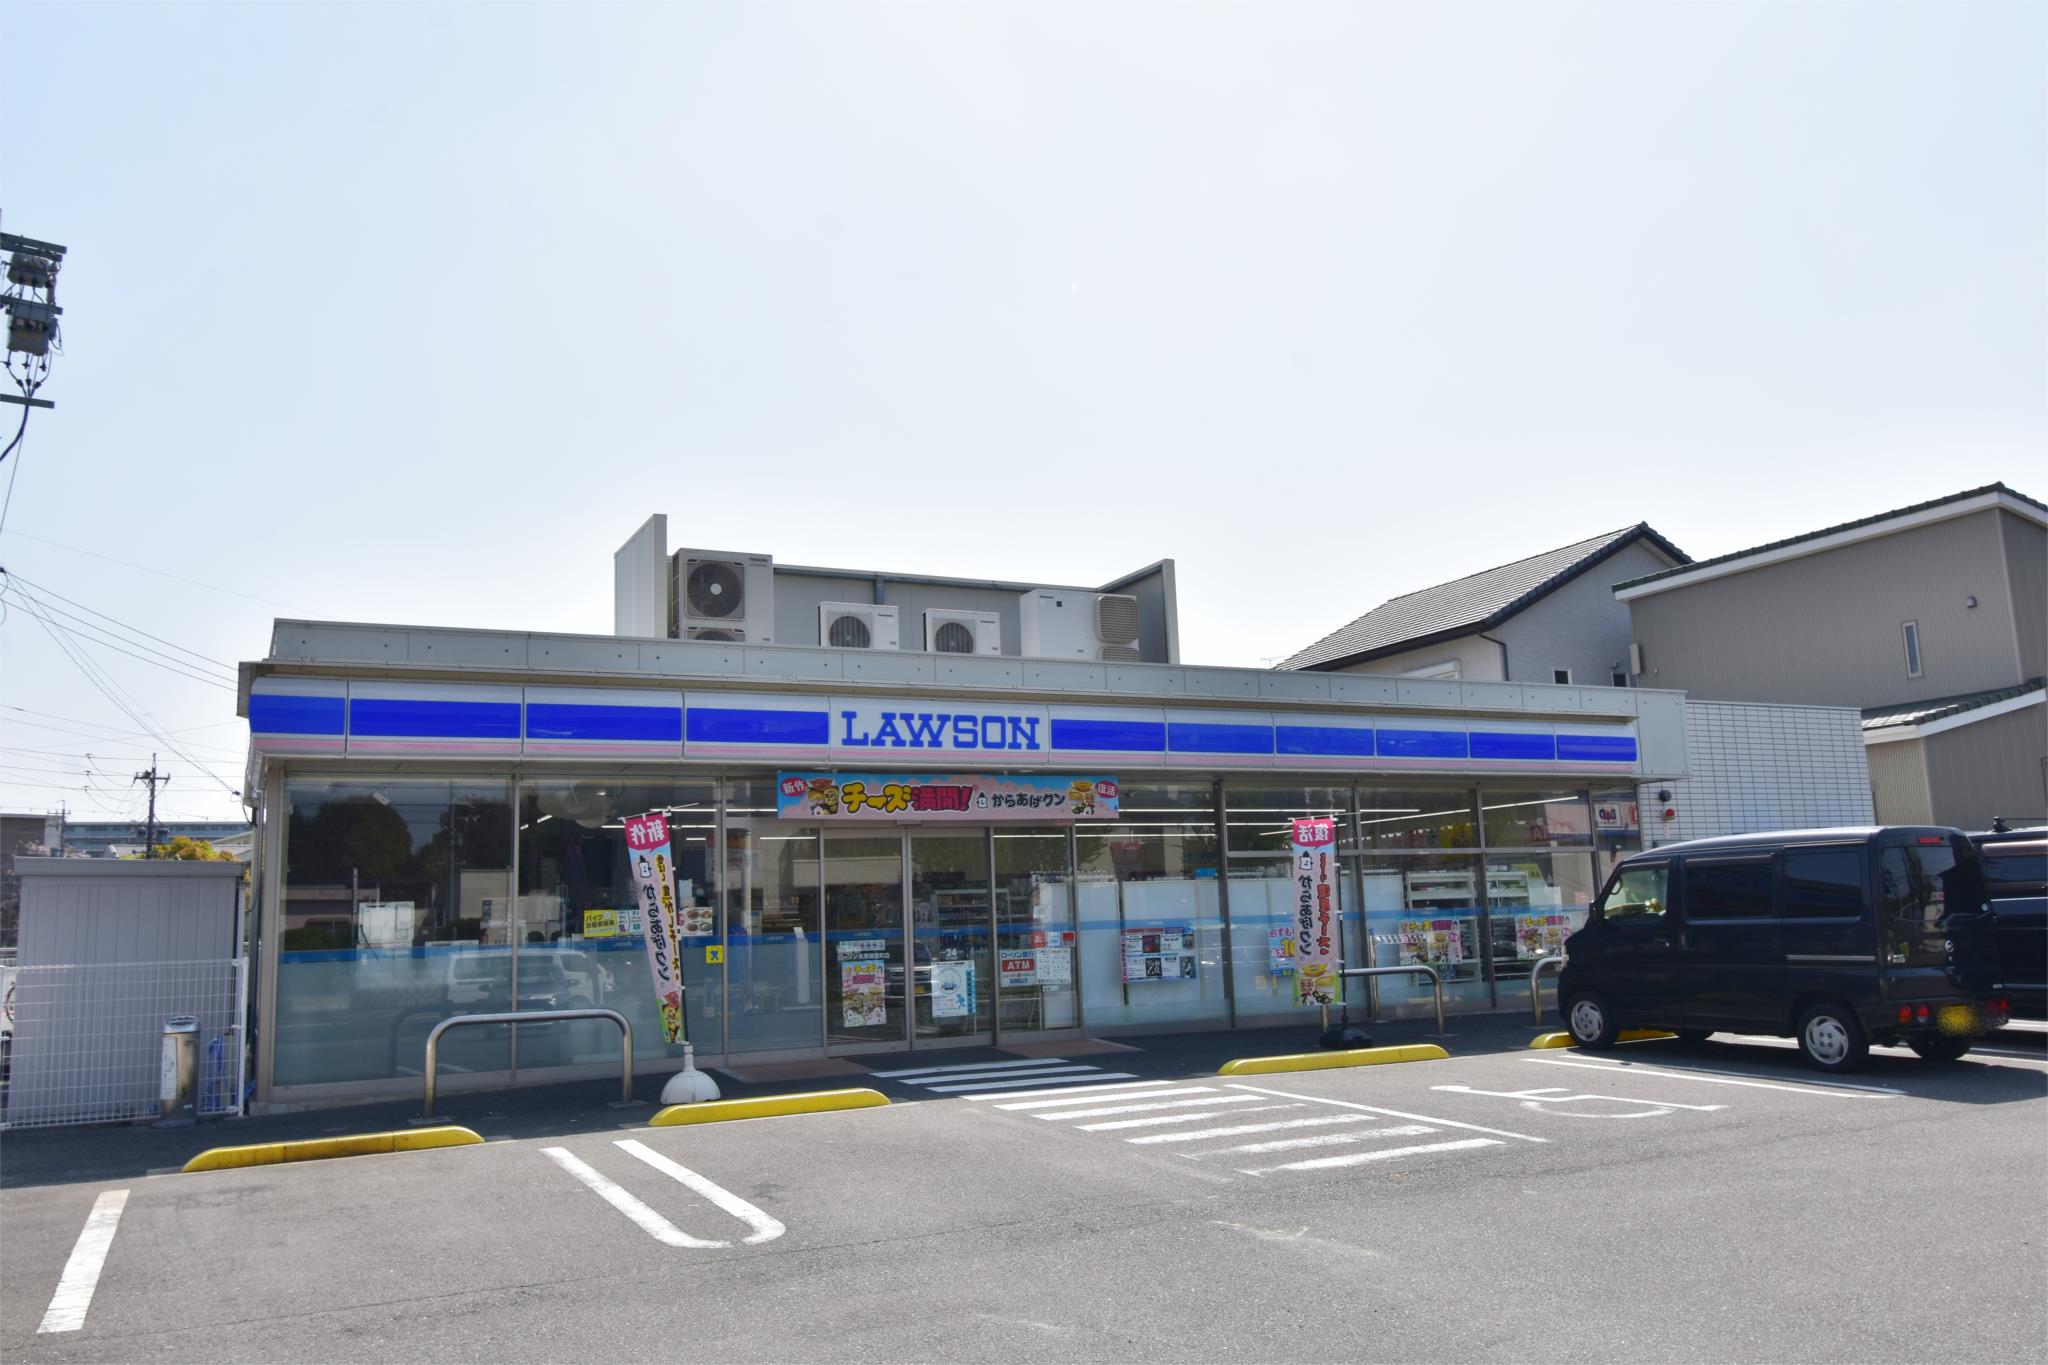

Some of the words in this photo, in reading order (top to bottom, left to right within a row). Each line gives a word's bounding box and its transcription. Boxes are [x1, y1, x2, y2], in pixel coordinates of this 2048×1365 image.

[841, 710, 1041, 751] LAWSON
[782, 780, 804, 795] 新作
[1097, 783, 1117, 797] 復活
[991, 792, 1067, 809] からあげクン
[1268, 927, 1295, 938] 必ずも
[945, 948, 957, 956] 24
[1007, 960, 1030, 971] ATM
